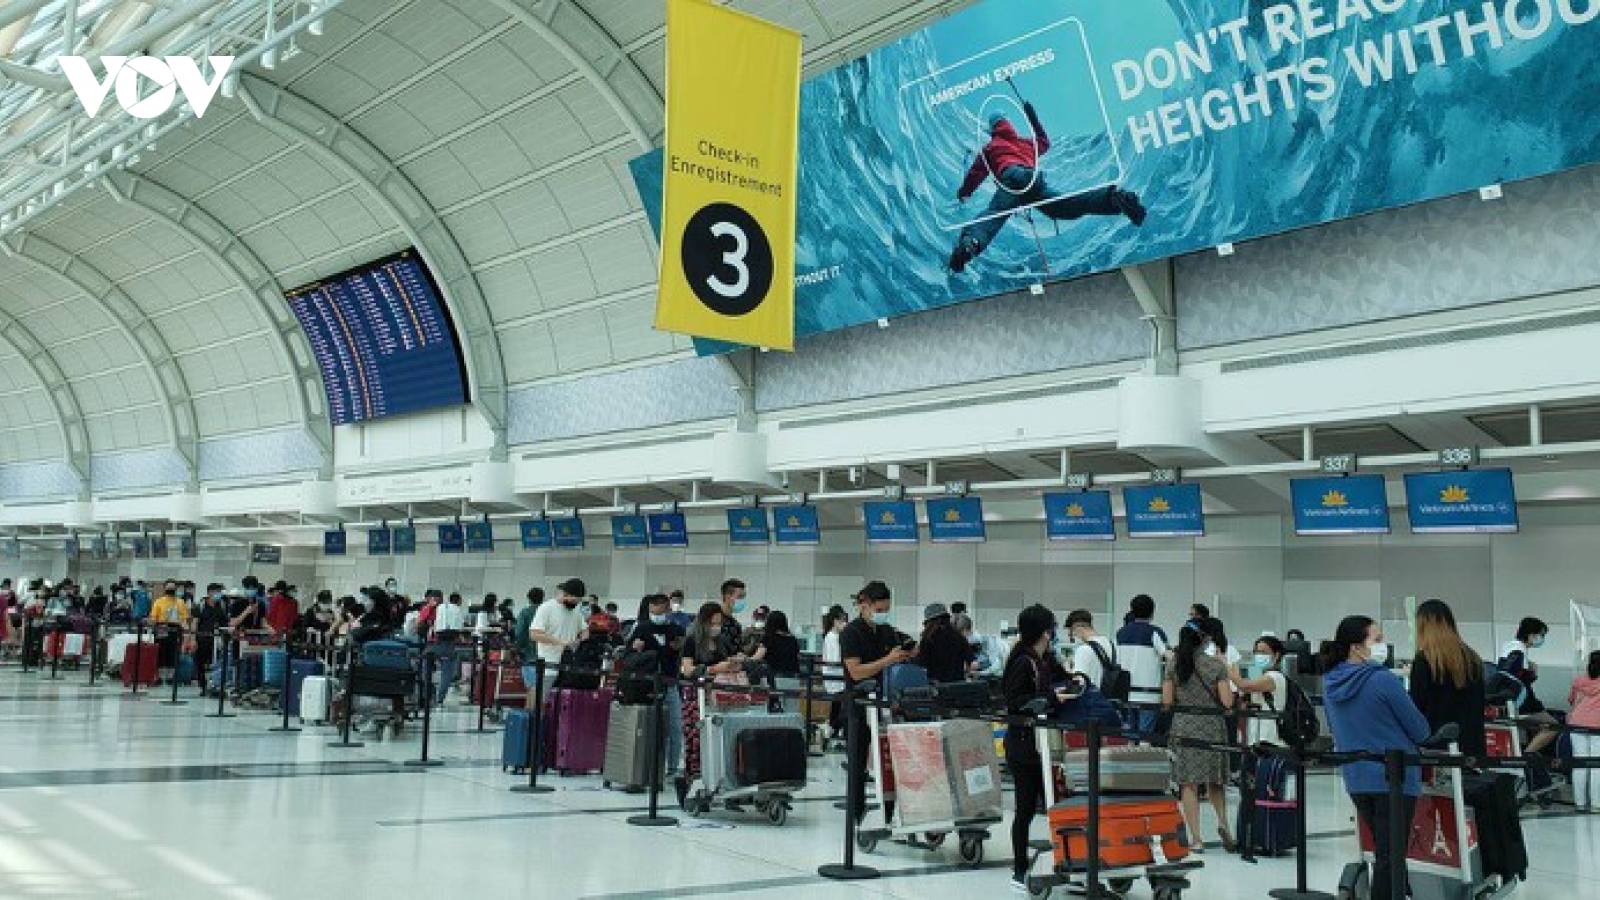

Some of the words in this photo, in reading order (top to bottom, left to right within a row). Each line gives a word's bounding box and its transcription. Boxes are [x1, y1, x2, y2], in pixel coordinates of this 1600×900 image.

[930, 72, 992, 105] AMERICAN
[993, 48, 1055, 82] EXPRESS
[1112, 16, 1249, 100] DON'T
[1127, 57, 1336, 153] HEIGHTS
[671, 154, 782, 198] Enregistrement
[698, 139, 759, 170] Check-in
[706, 221, 750, 298] 3
[1323, 456, 1350, 472] 337
